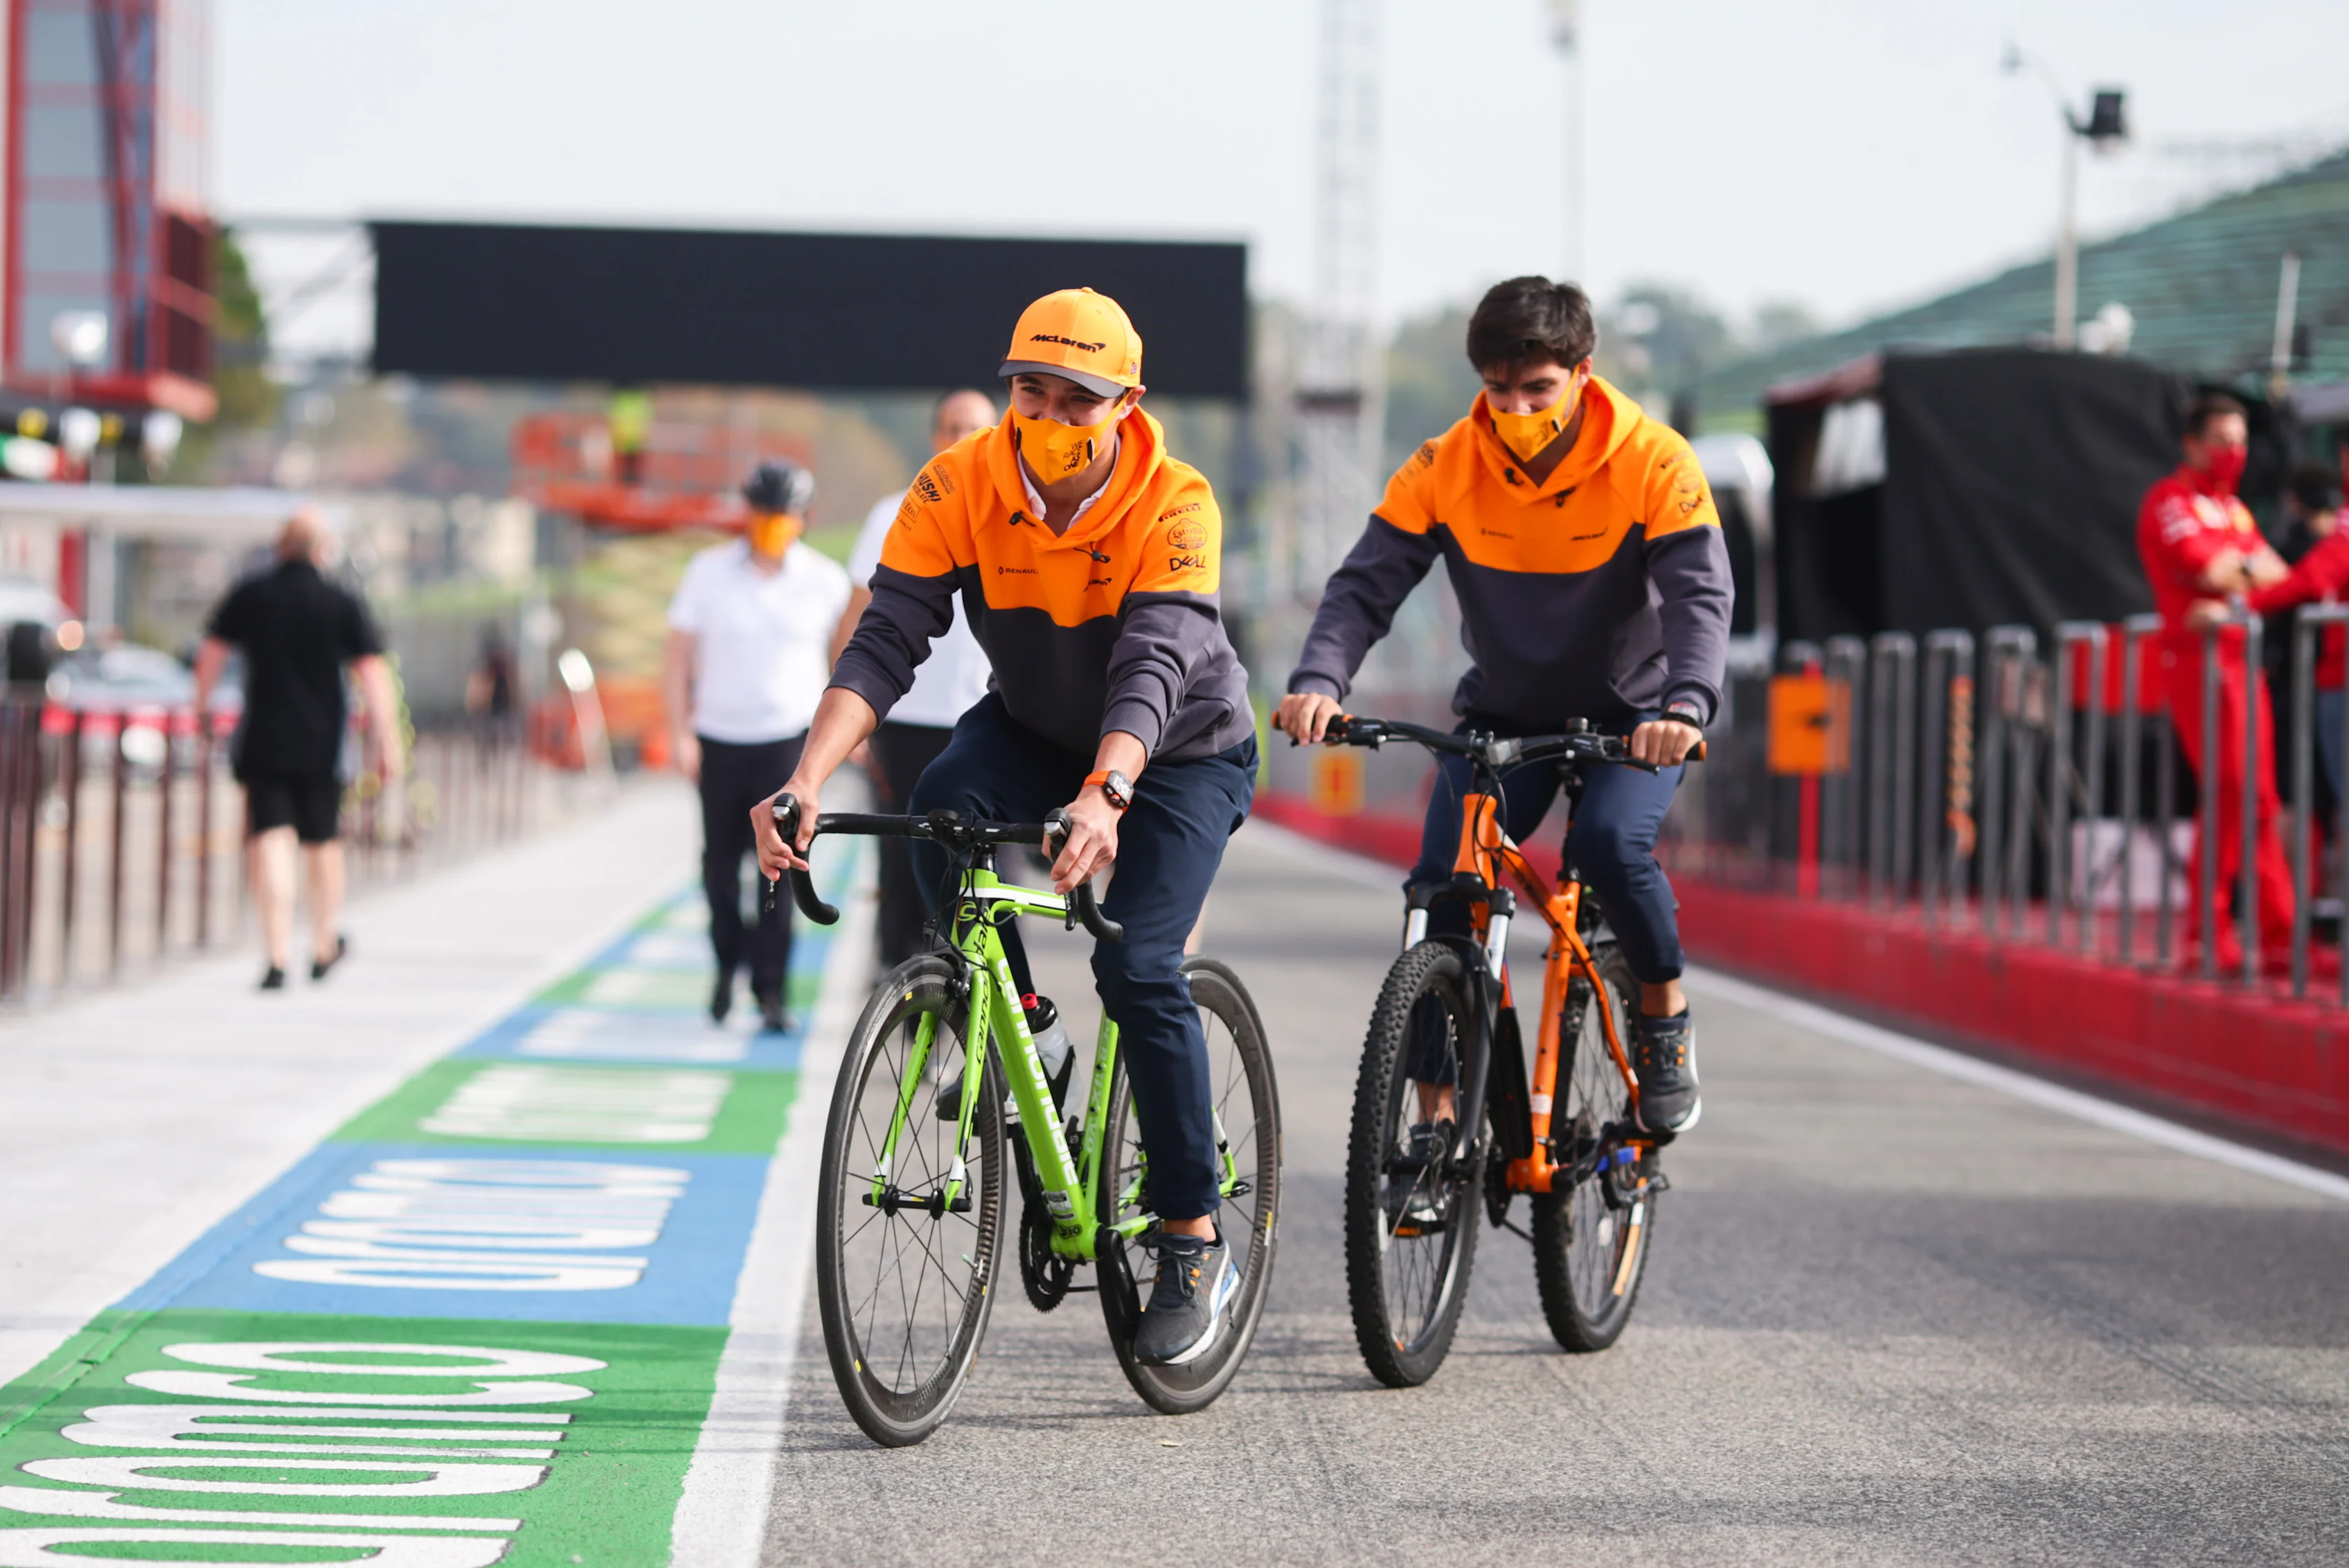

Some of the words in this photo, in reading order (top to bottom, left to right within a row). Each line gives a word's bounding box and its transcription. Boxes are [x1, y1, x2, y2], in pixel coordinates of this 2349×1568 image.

[1030, 334, 1097, 353] McLaren
[1169, 554, 1206, 571] DELL
[0, 1342, 609, 1568] aramco
